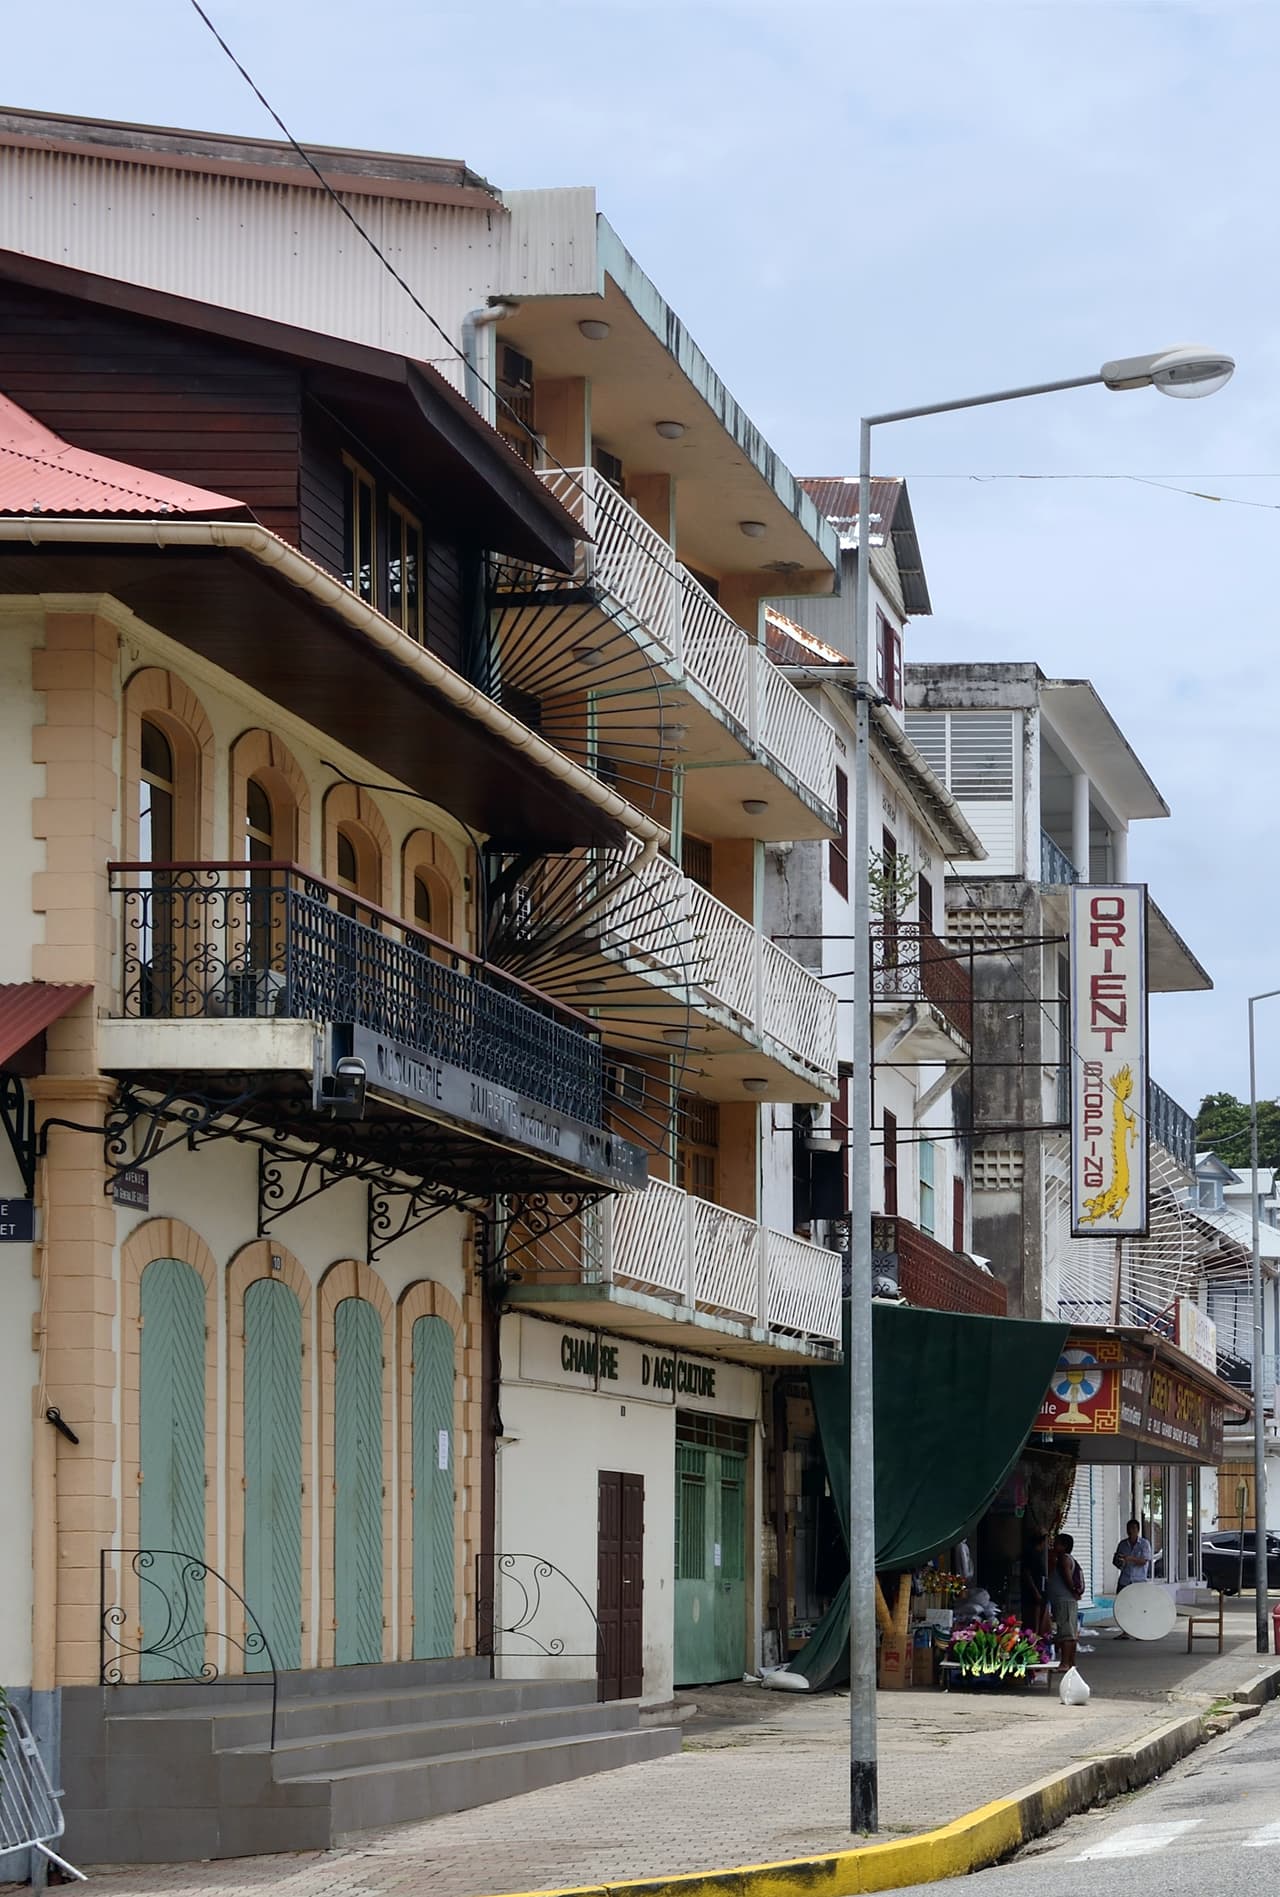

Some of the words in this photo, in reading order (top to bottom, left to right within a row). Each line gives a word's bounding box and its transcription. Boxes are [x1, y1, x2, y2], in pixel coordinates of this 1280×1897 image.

[1090, 897, 1127, 1052] ORIENT
[377, 1043, 442, 1101] BIJOUTERIE
[1083, 1061, 1103, 1188] SHOPPING
[125, 1171, 145, 1186] AVENUE
[561, 1334, 618, 1380] CHAMBRE
